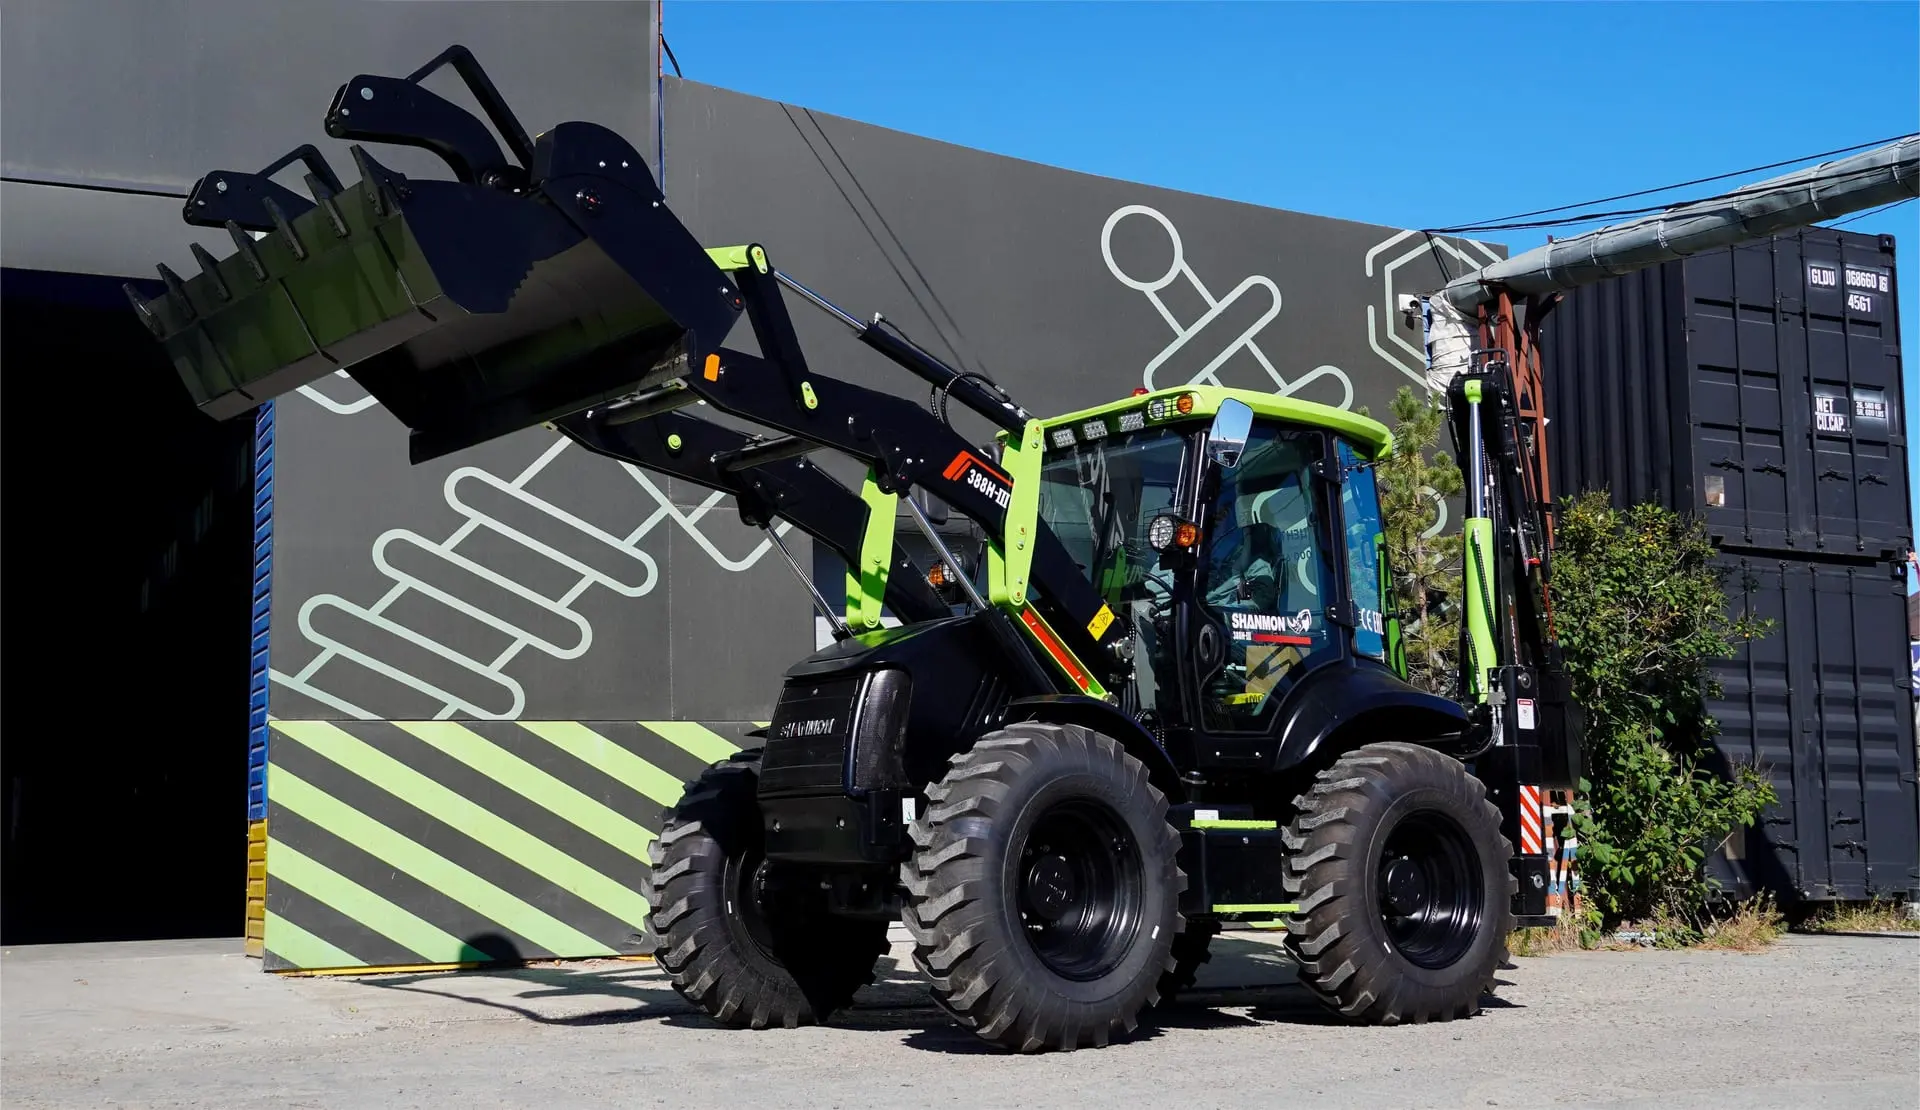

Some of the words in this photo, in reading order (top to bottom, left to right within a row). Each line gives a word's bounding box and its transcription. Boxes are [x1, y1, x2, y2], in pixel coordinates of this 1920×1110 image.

[1811, 268, 1835, 286] GLDU
[1846, 270, 1877, 289] 068660
[1847, 294, 1871, 312] 45G1
[1816, 397, 1834, 413] NET
[1816, 415, 1846, 432] CU.CAP.
[1231, 612, 1287, 632] SHANMON
[780, 718, 835, 738] SHANMON
